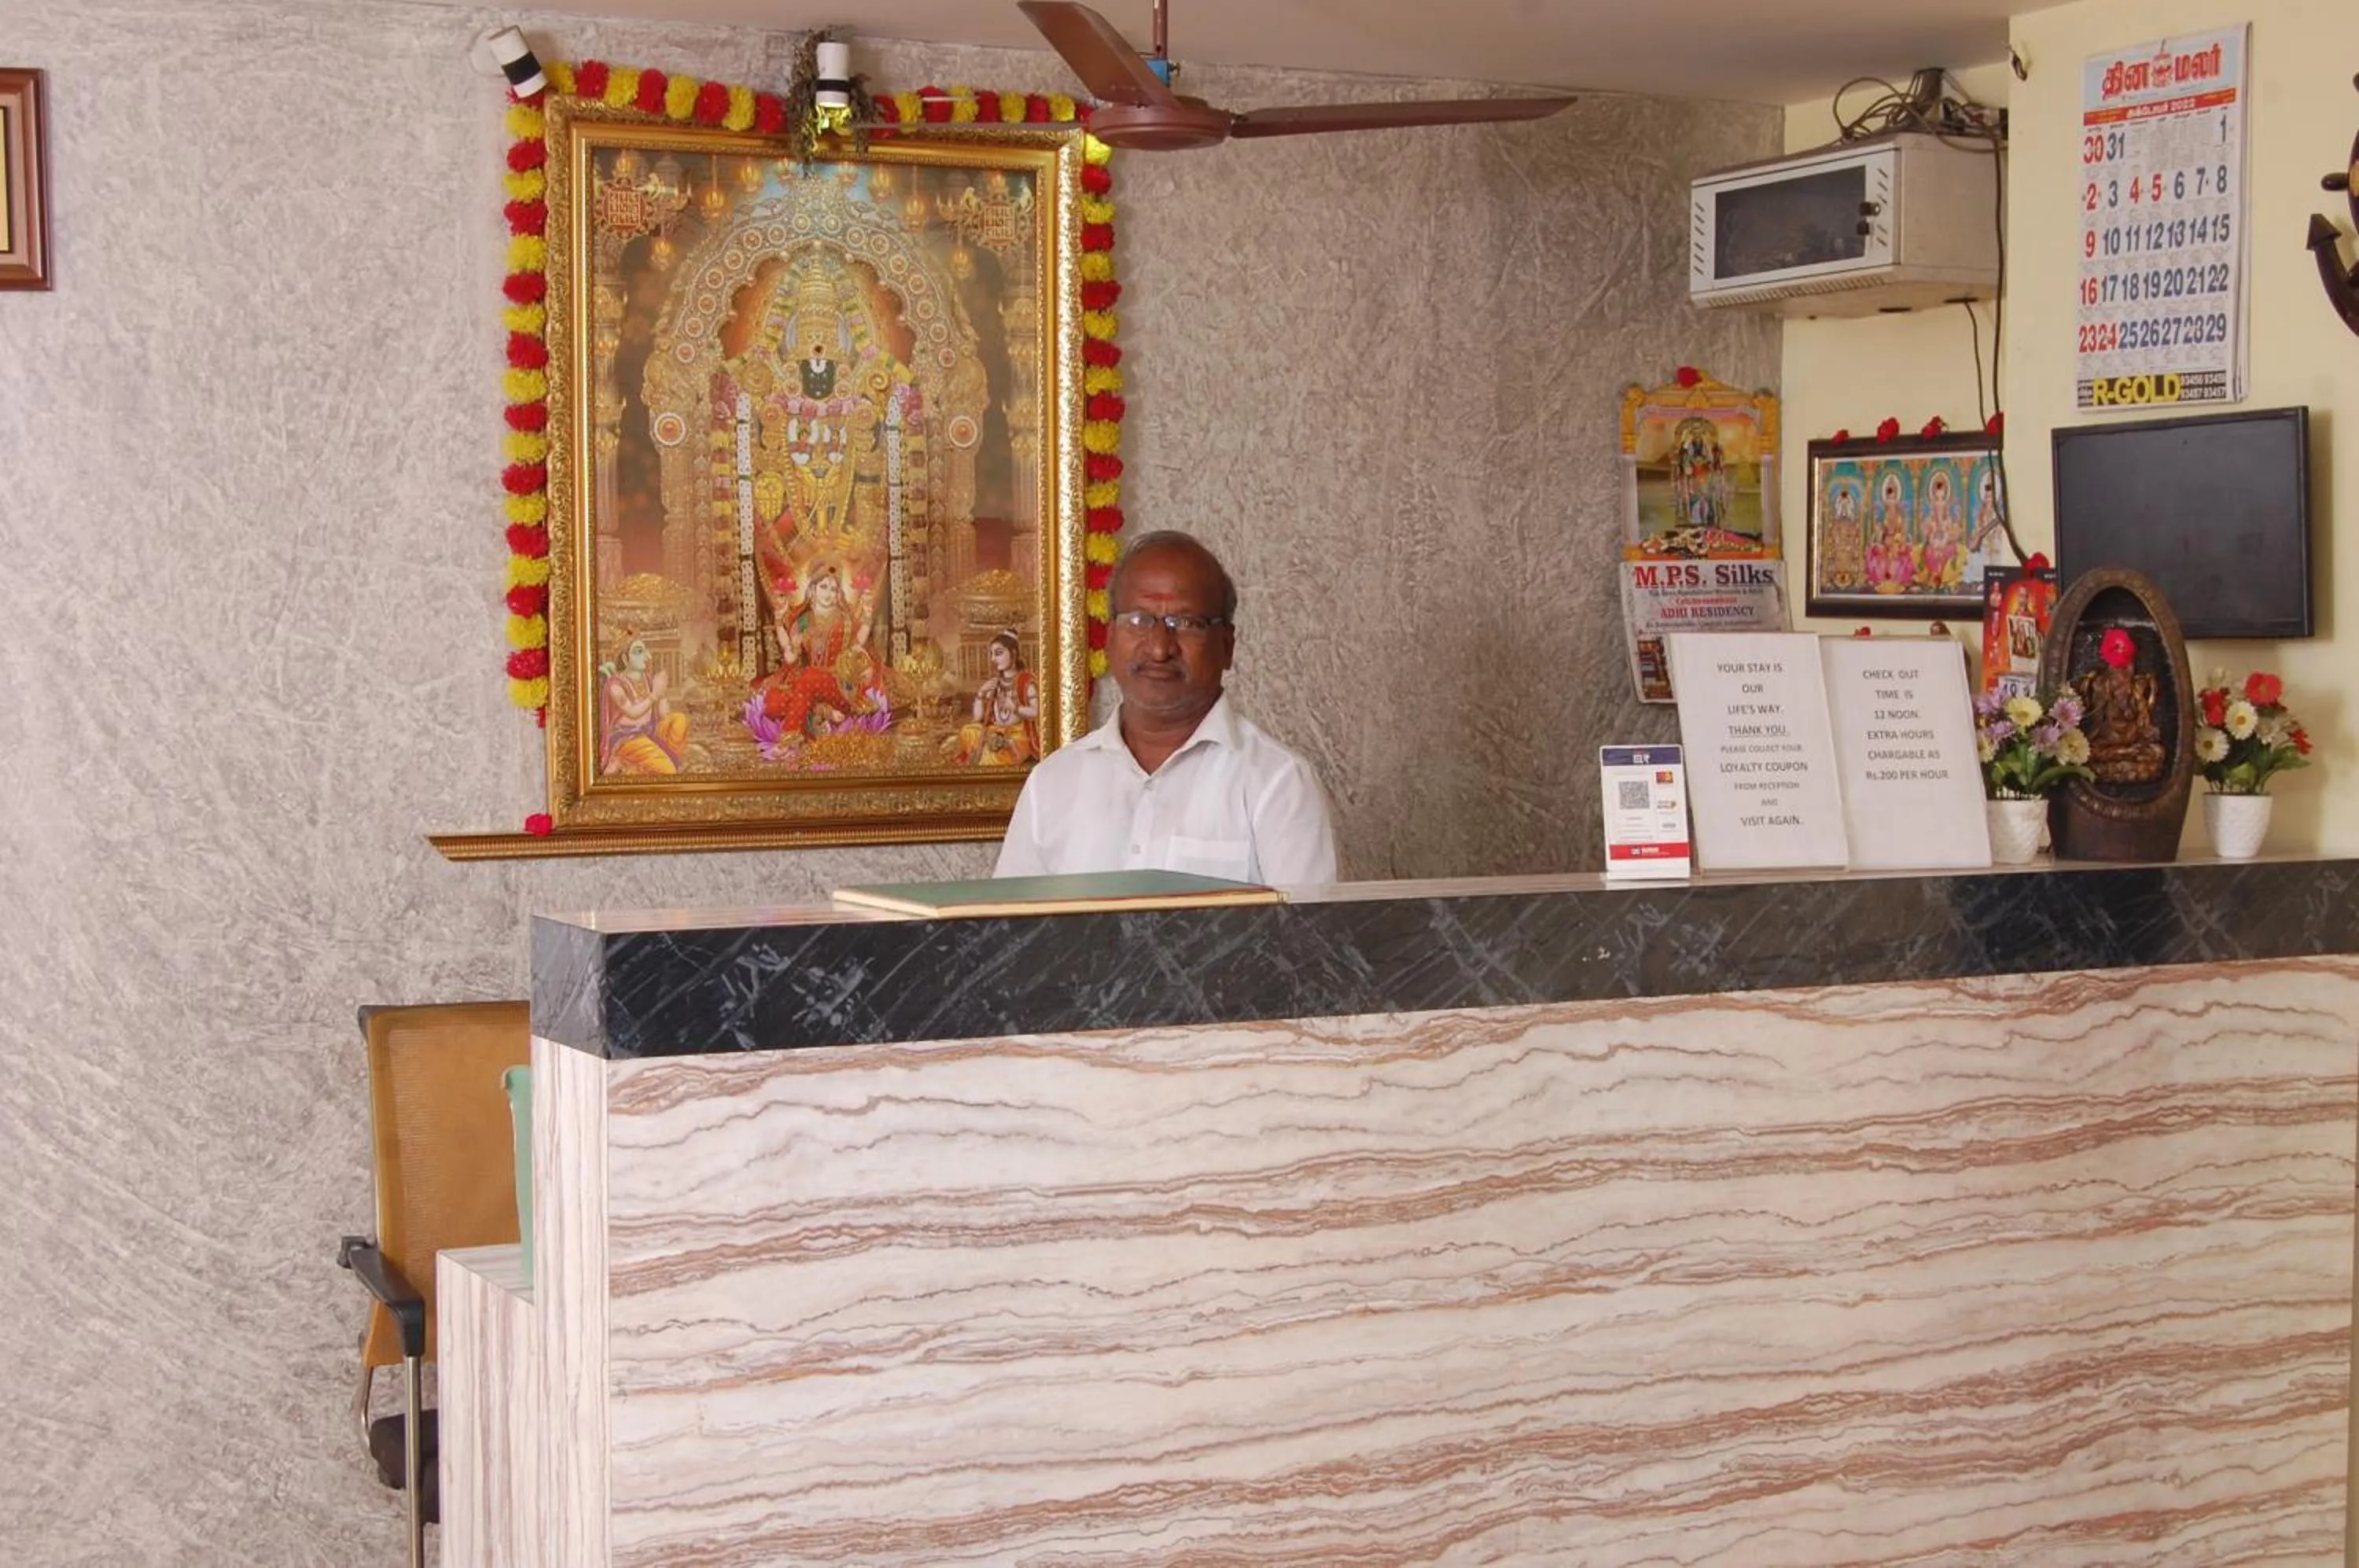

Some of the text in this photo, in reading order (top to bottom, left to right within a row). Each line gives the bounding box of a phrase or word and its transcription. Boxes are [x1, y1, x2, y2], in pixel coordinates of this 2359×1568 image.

[2084, 114, 2227, 164] 30 31 1
[2086, 164, 2227, 211] 2 3 4 5 6 7 8
[2085, 213, 2230, 258] 9 10 11 12 13 14 15
[2081, 263, 2229, 305] 16 17 18 19 20 21 22
[2078, 312, 2226, 353] 23 24 25 26 27 28 29
[2092, 372, 2181, 406] R-GOLD
[1634, 564, 1774, 588] M.P.S. Silks
[1691, 605, 1755, 618] RESIDENCY
[1717, 663, 1745, 673] YOUR
[1746, 662, 1772, 673] STAY
[1862, 669, 1919, 679] CHECK OUT
[1742, 683, 1764, 693] OUR
[1875, 690, 1913, 699] TIME IS
[1728, 724, 1762, 735] THANK
[1868, 729, 1935, 740] EXTRA HOURS
[1868, 749, 1941, 760] CHARGABLE AS
[1720, 760, 1809, 773] LOYALTY COUPON
[1899, 770, 1919, 780] PER
[1739, 815, 1765, 826] VISIT
